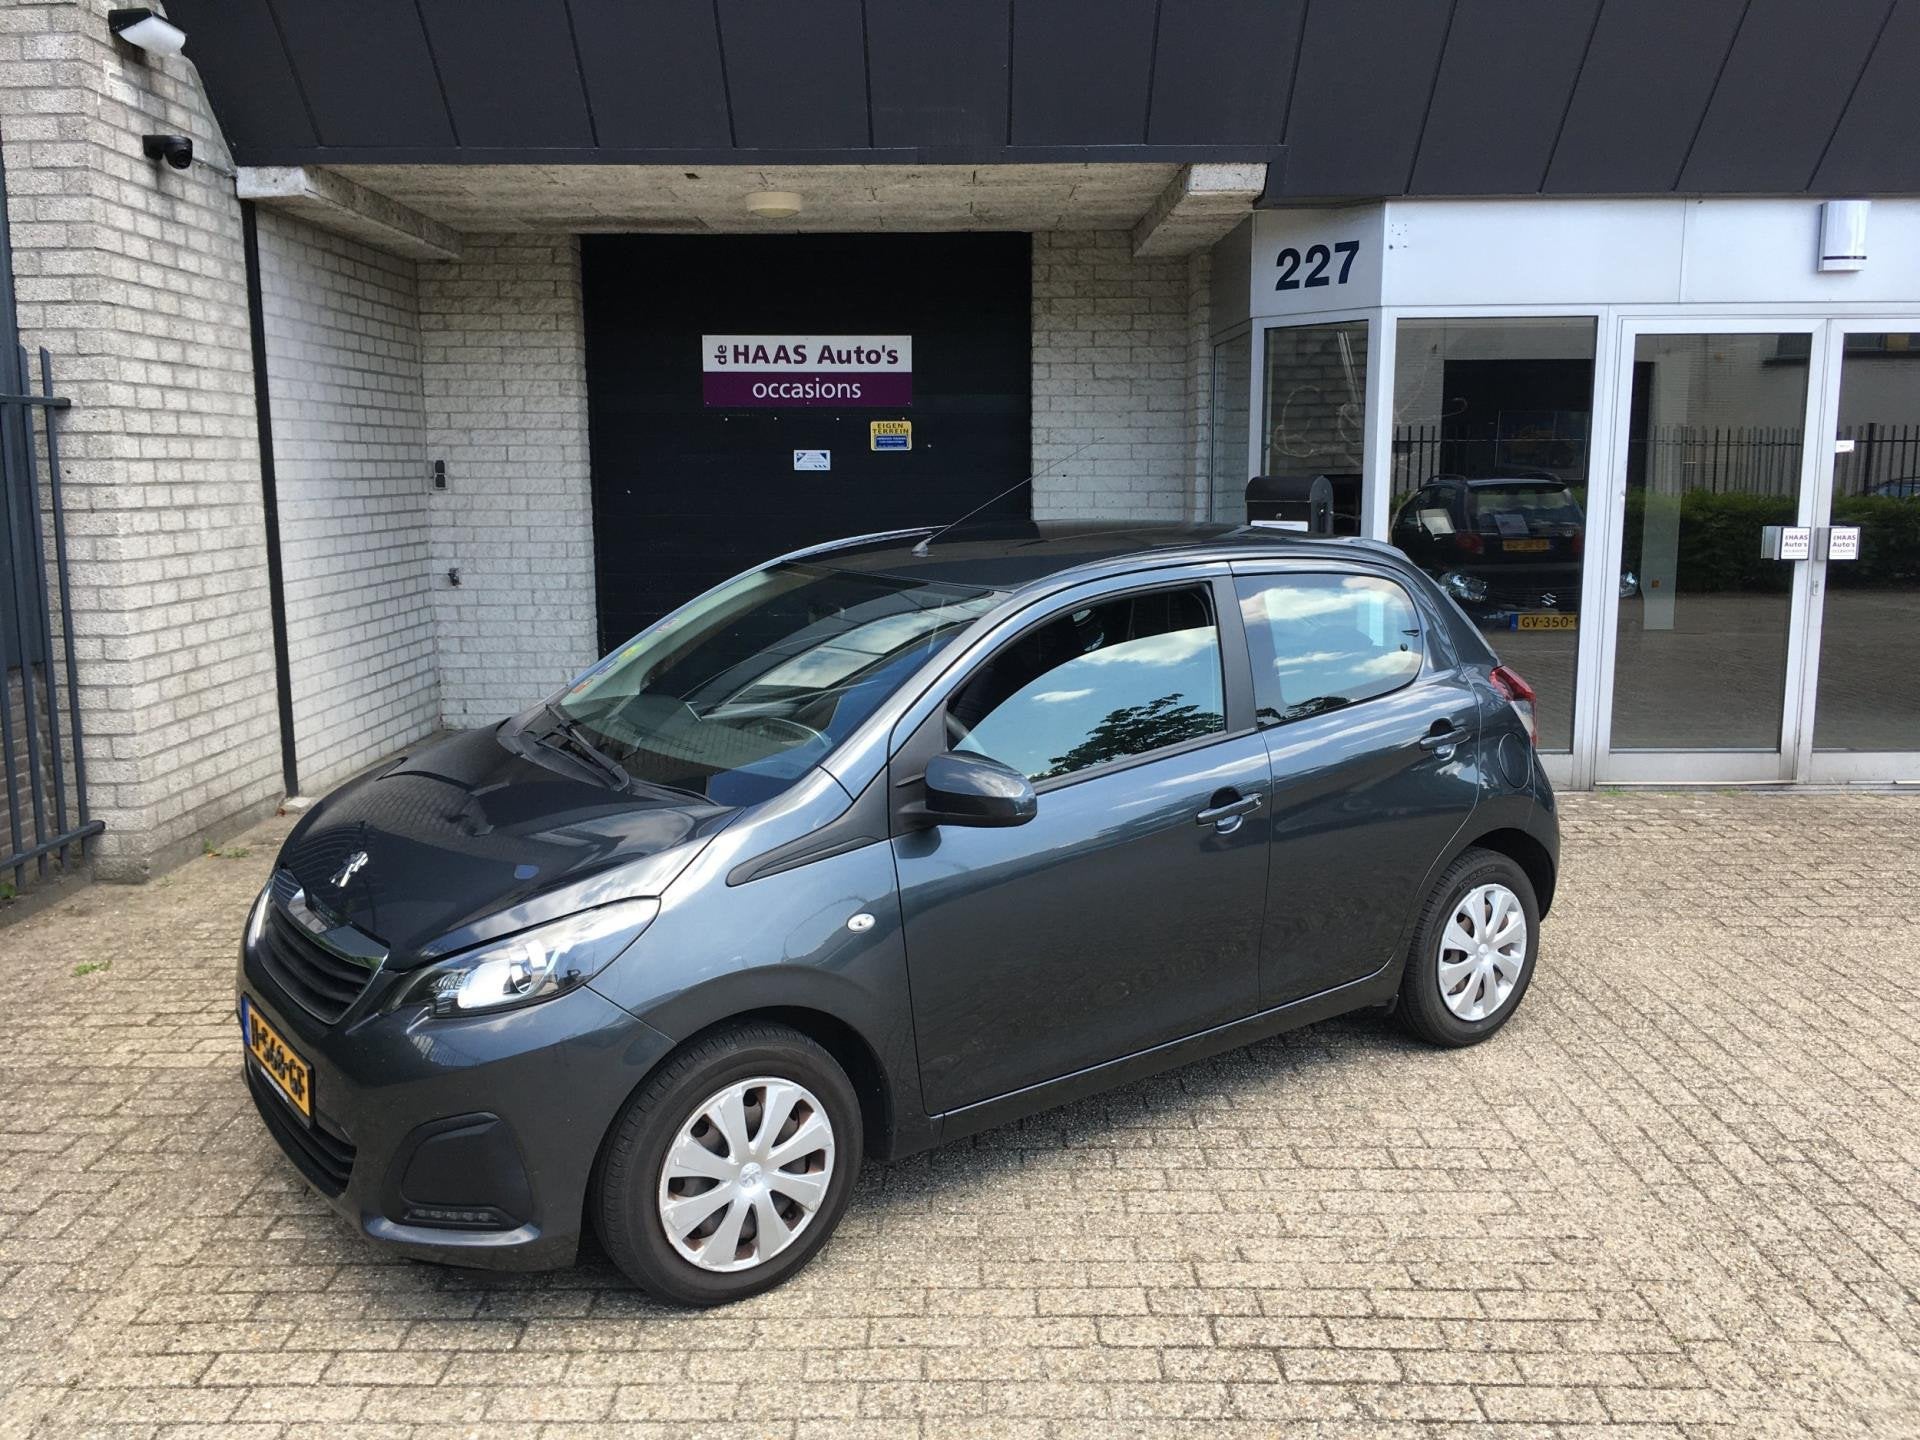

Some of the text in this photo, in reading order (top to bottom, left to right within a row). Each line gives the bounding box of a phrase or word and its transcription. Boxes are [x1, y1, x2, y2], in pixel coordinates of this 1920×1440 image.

[1275, 240, 1360, 291] 227
[714, 344, 899, 365] de HAAS Auto's
[752, 377, 862, 399] occasions
